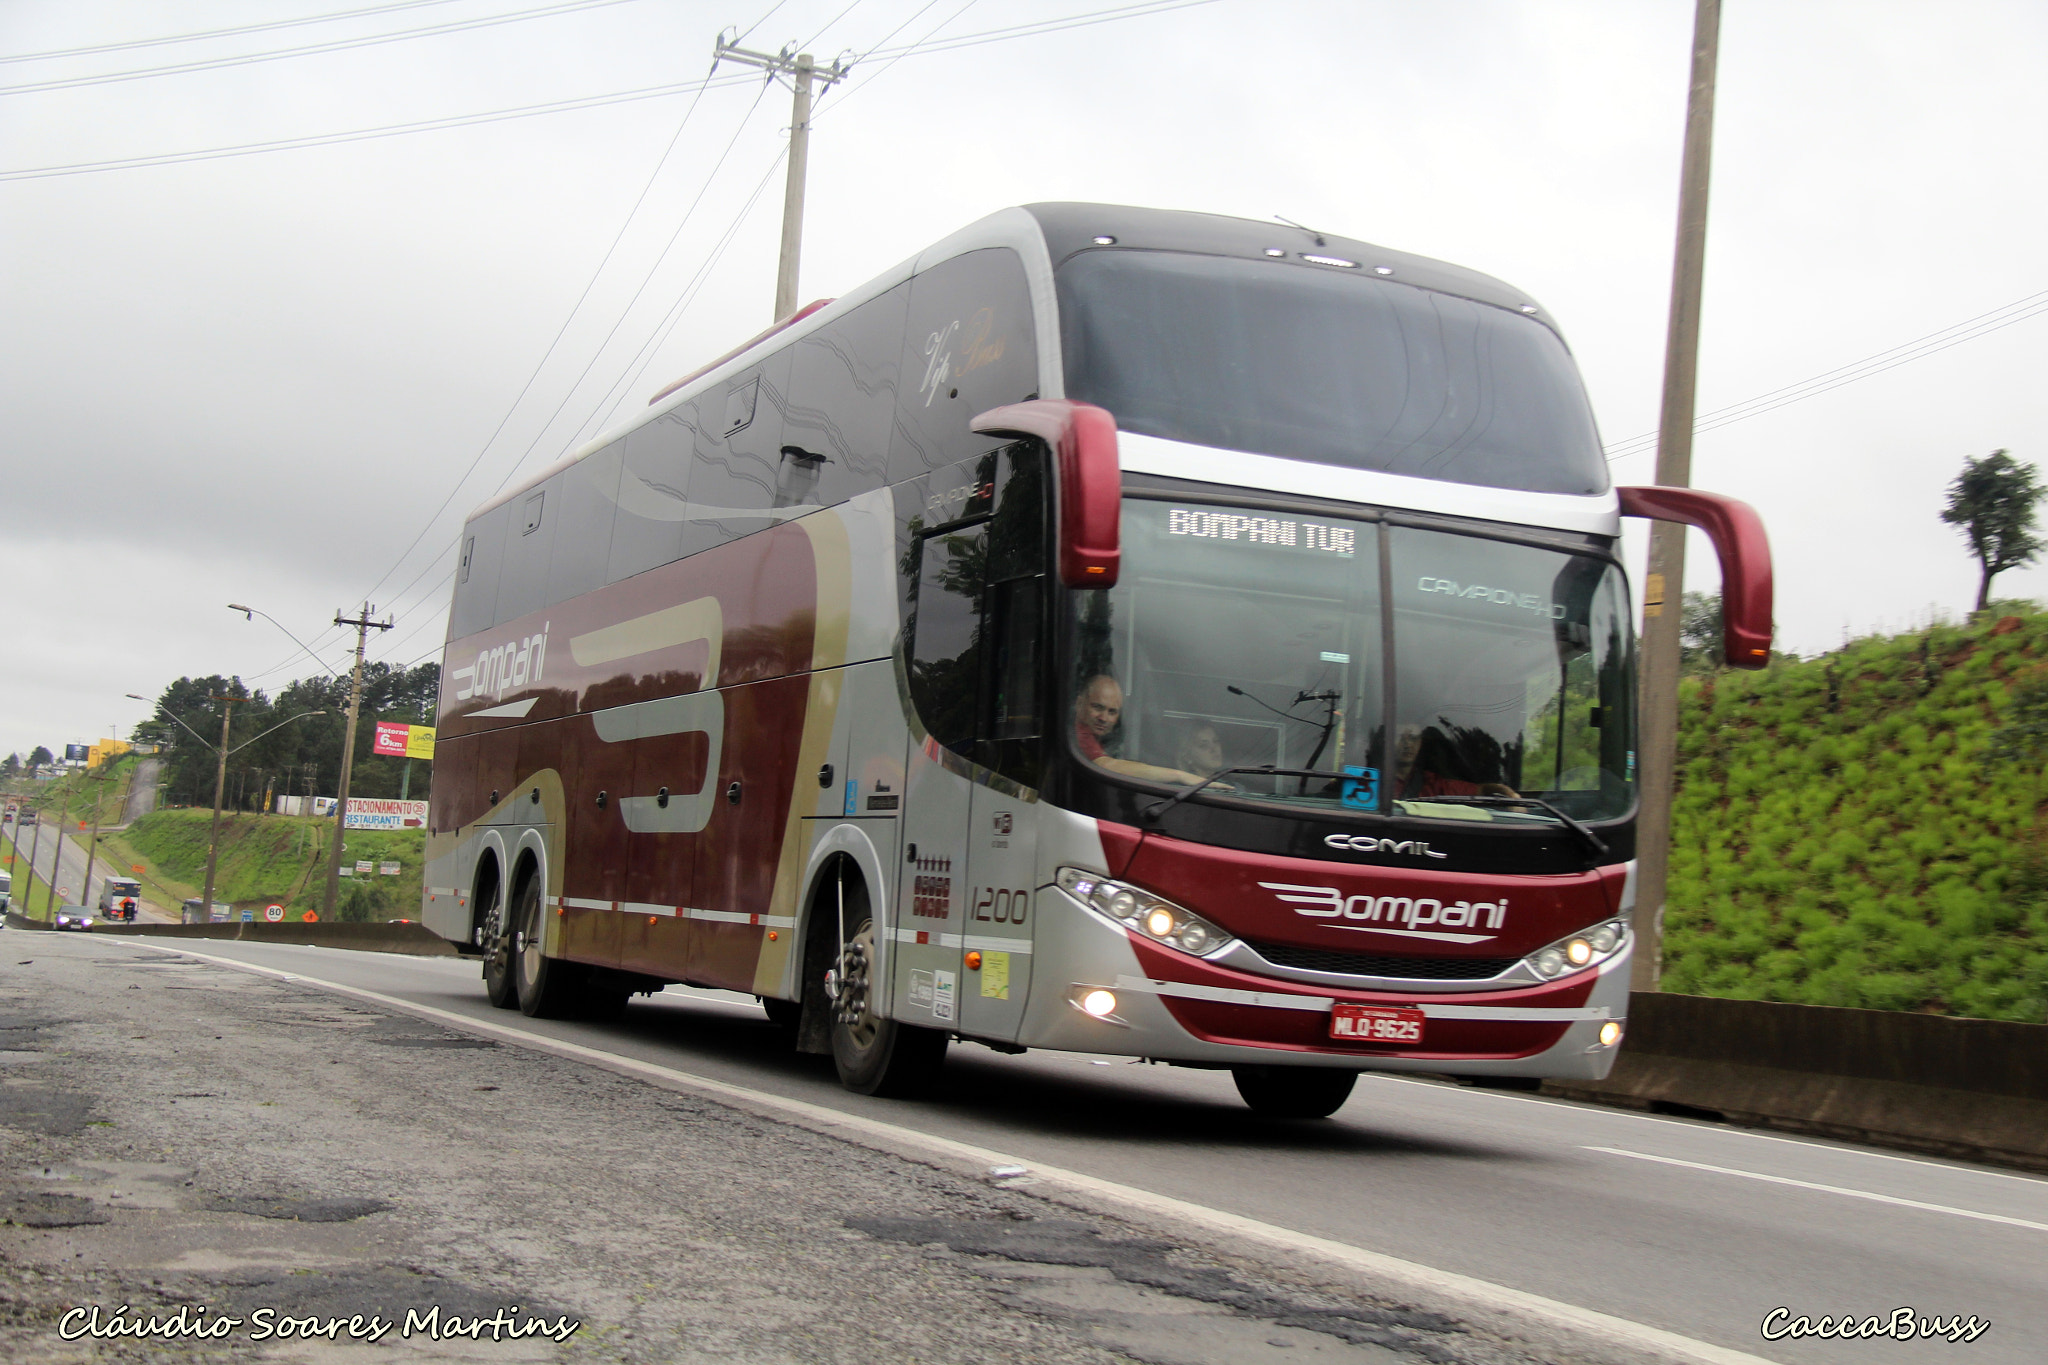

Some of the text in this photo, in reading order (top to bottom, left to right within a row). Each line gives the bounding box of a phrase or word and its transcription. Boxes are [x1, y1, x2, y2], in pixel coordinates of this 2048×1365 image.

[1169, 509, 1355, 554] BOMPANI TUR
[1417, 576, 1540, 609] CAMPIONE
[378, 726, 409, 736] Retorno
[345, 814, 401, 825] RESTAURANTE
[347, 799, 412, 815] STACIONAMENTO
[1324, 833, 1447, 859] COMIL
[268, 907, 282, 916] 80
[970, 886, 1028, 925] 1200
[1256, 881, 1509, 930] Bompani
